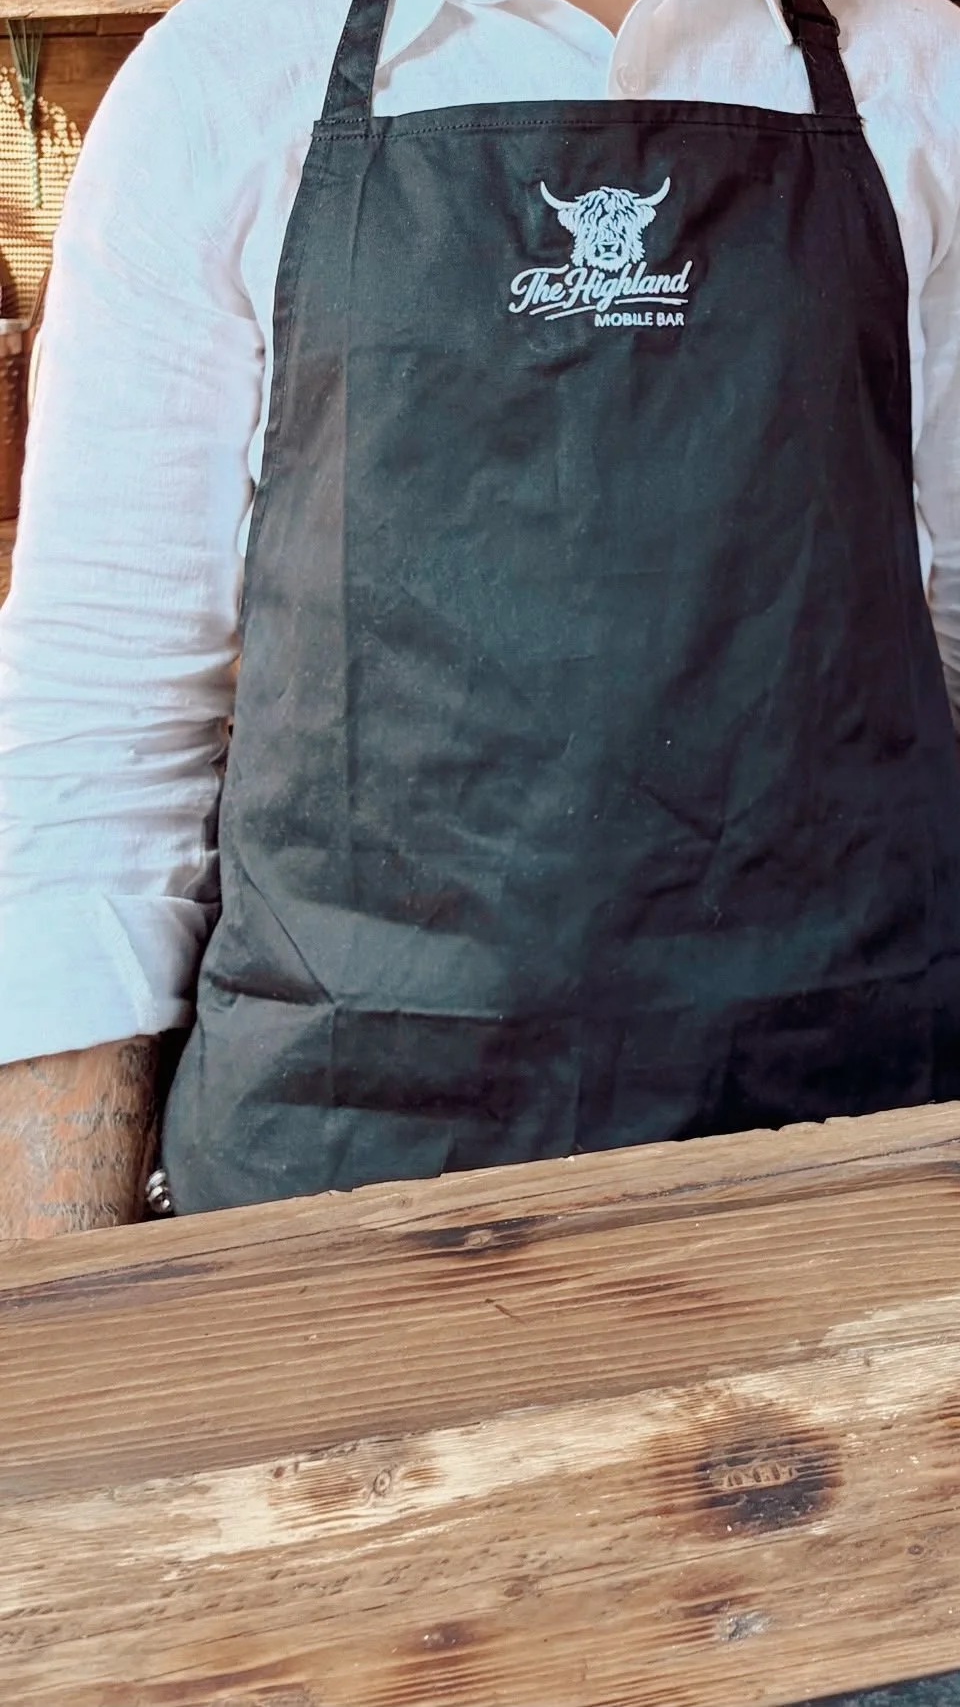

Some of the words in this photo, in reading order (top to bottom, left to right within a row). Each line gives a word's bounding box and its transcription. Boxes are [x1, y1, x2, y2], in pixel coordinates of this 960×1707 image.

[510, 264, 569, 313] The
[563, 260, 693, 312] Highland
[594, 312, 653, 328] MOBILE
[656, 312, 685, 327] BAR
